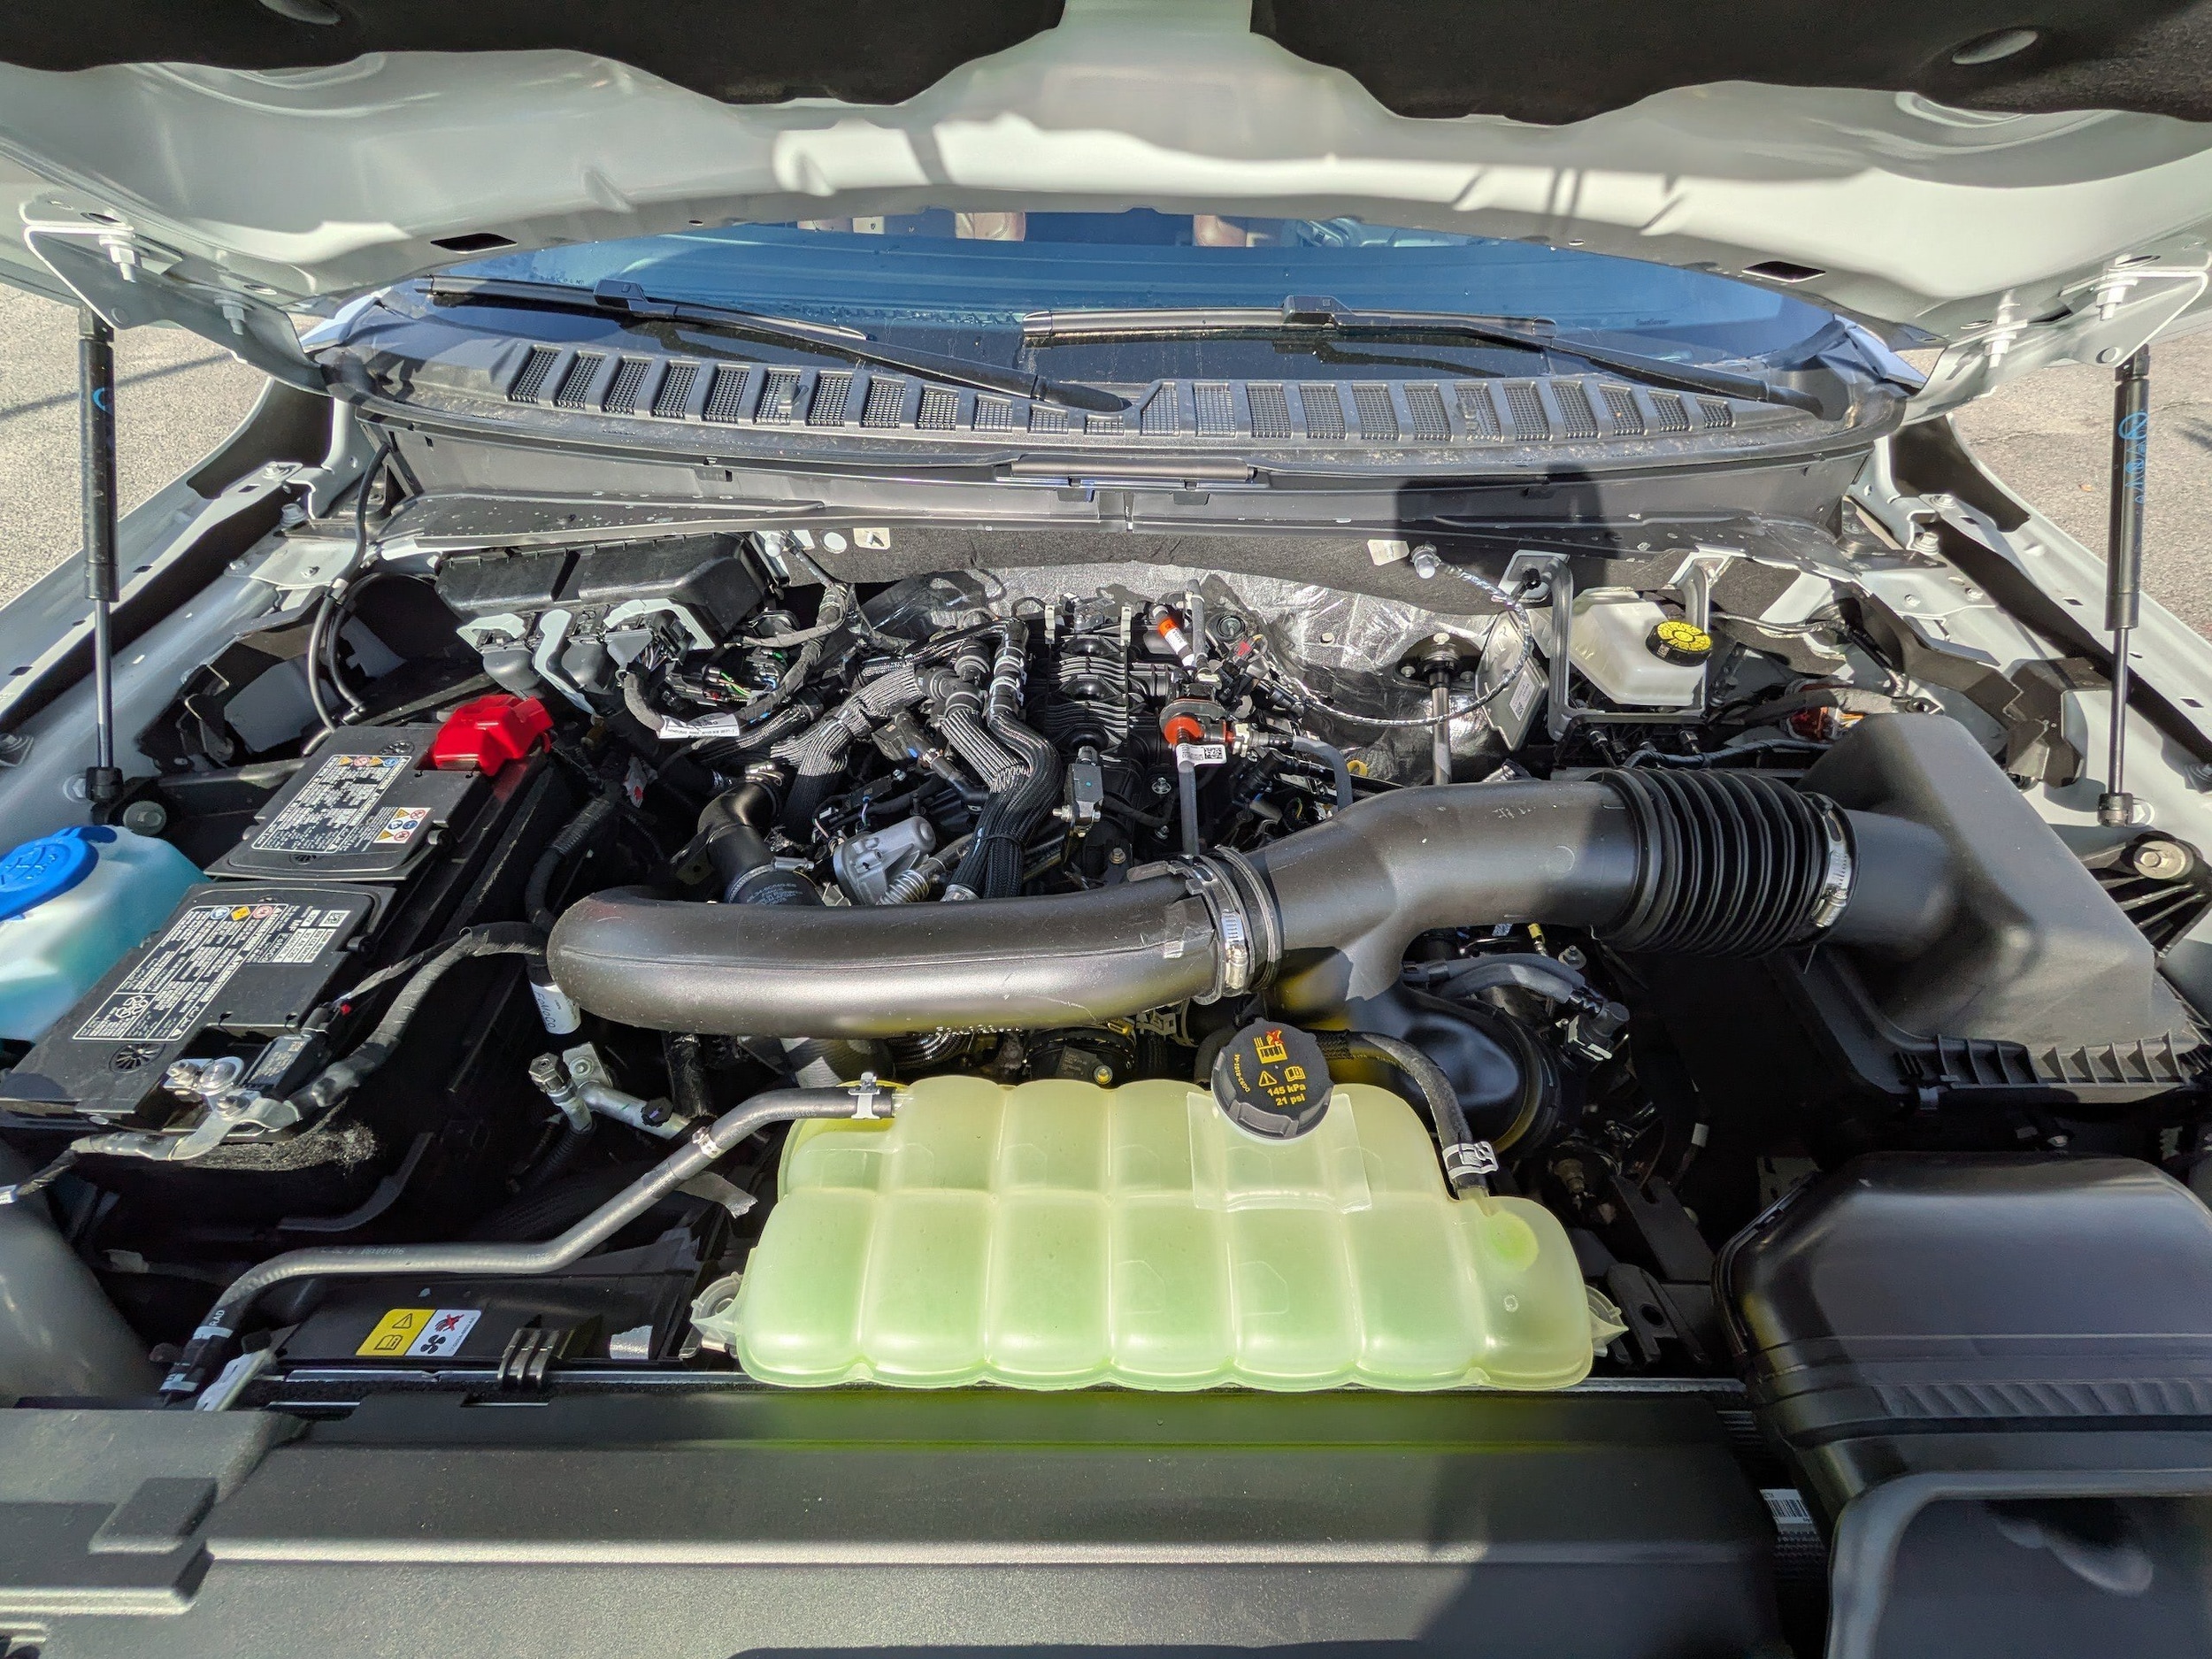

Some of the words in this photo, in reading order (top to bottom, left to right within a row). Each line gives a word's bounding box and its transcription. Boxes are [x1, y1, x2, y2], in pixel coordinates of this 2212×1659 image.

[534, 991, 556, 1028] FoMoCo
[1267, 1087, 1286, 1097] 145
[1286, 1083, 1306, 1094] kPa
[1275, 1096, 1288, 1106] 21
[1290, 1094, 1305, 1105] psi
[209, 1310, 226, 1326] RAD
